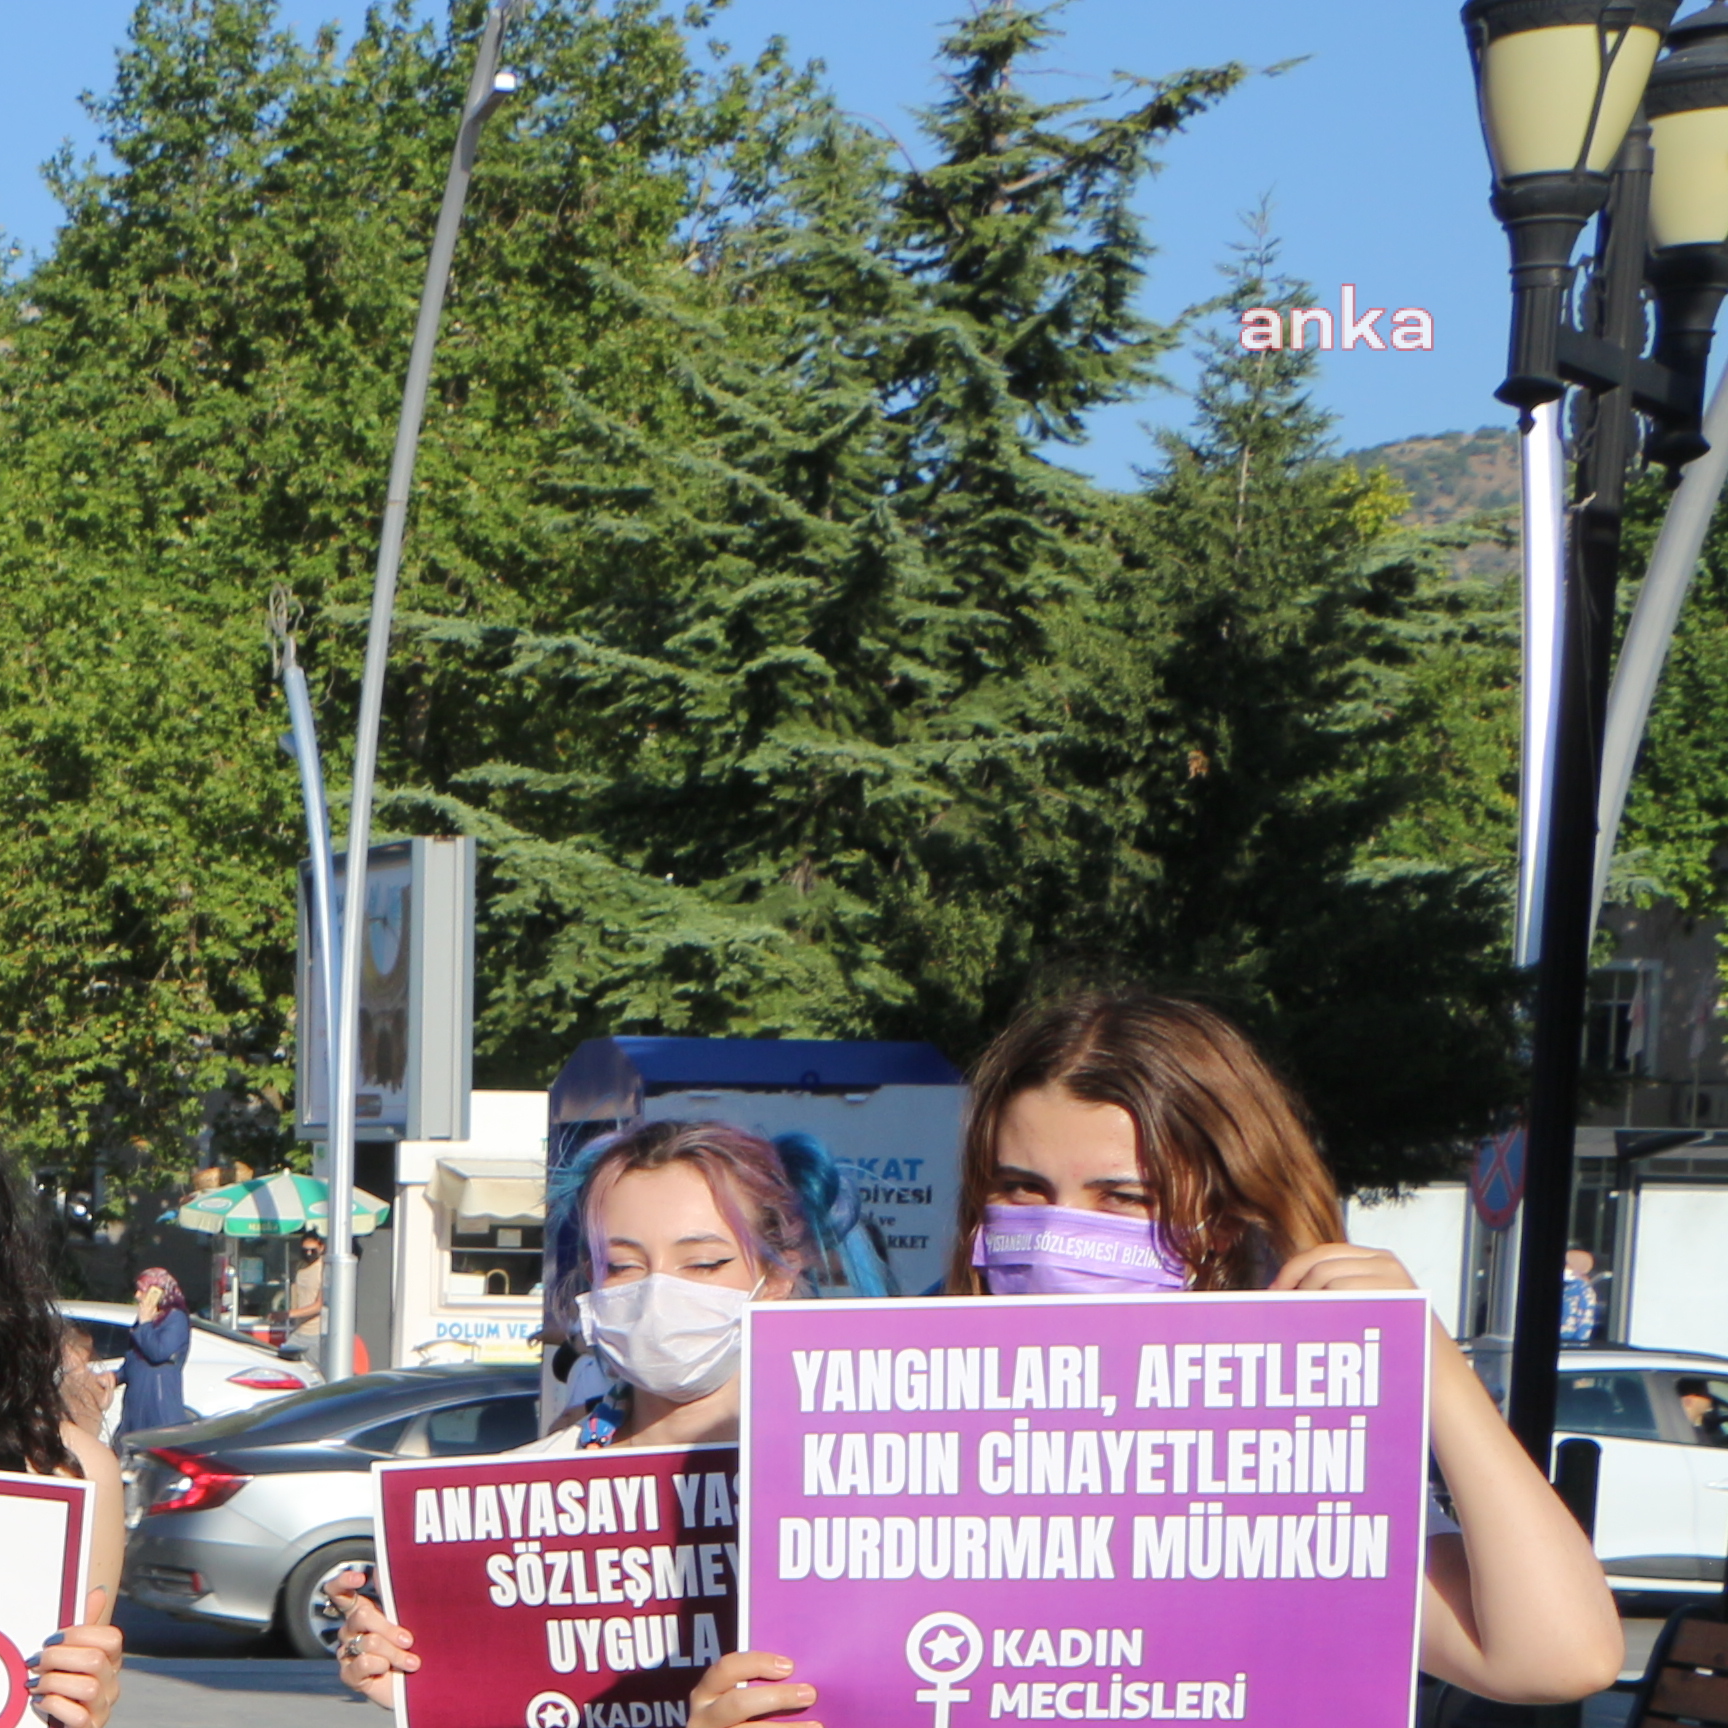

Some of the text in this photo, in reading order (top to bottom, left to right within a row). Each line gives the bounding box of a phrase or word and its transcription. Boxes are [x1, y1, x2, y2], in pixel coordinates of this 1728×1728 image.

[1034, 1230, 1120, 1263] SÖZLEŞMESİ
[436, 1322, 501, 1339] DOLUM
[507, 1323, 528, 1339] VE
[791, 1327, 1382, 1417] YANGINLARI, AFETLERİ
[802, 1415, 1367, 1496] KADIN CİNAYETLERİNİ
[413, 1472, 739, 1545] ANAYASAYI YA
[777, 1501, 1390, 1580] DURDURMAK MÜMKÜN
[545, 1612, 722, 1673] UYGULA
[991, 1626, 1144, 1668] KADIN
[989, 1672, 1247, 1720] MECLİSLERİ
